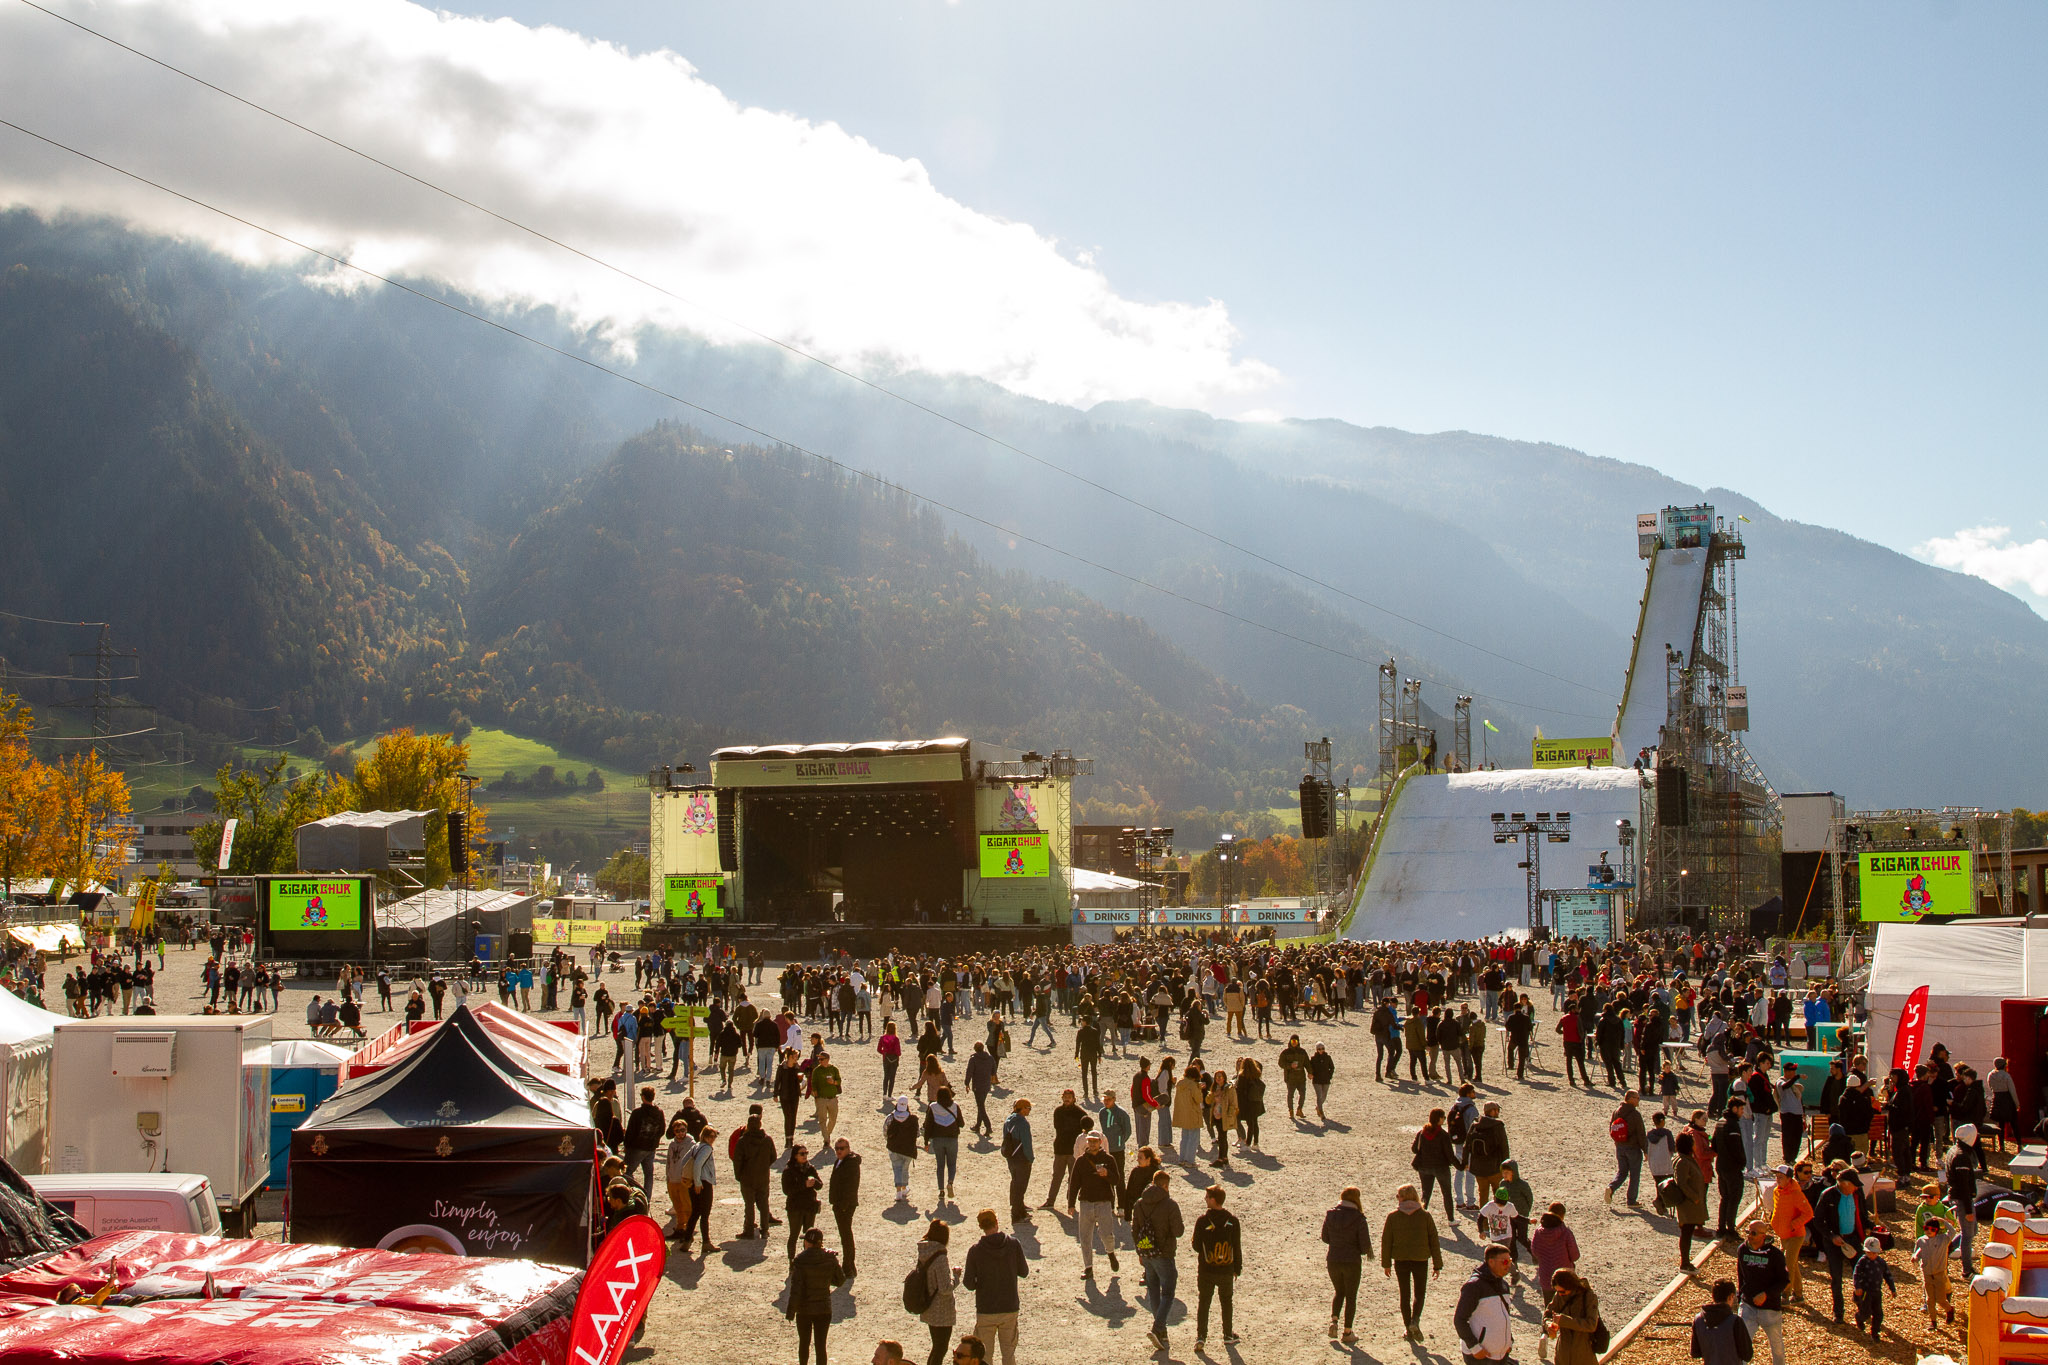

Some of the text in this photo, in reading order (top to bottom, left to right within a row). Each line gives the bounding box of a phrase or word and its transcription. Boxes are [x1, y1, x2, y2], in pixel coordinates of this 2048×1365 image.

[1094, 913, 1130, 921] DRINKS
[1175, 912, 1212, 921] DRINKS
[1257, 911, 1295, 920] DRINKS
[430, 1200, 498, 1227] Simply
[468, 1224, 534, 1250] enjoy!
[575, 1237, 653, 1365] LAAX
[610, 1328, 622, 1348] Laax
[620, 1300, 637, 1327] Falera
